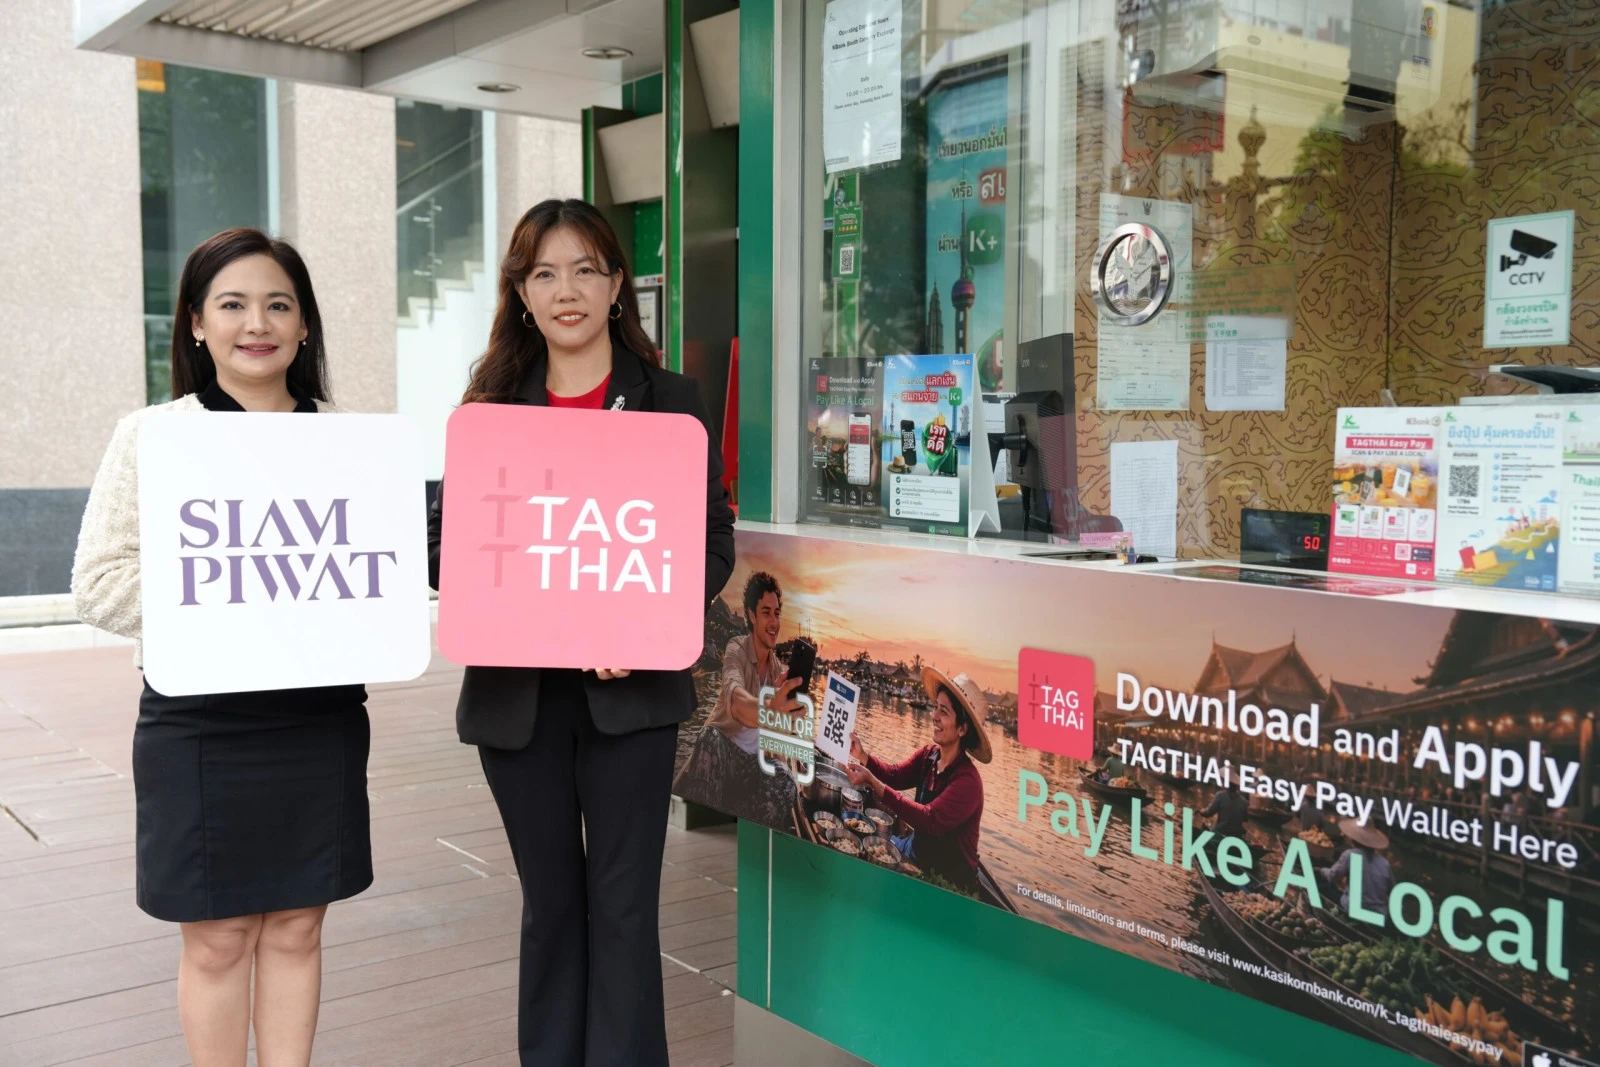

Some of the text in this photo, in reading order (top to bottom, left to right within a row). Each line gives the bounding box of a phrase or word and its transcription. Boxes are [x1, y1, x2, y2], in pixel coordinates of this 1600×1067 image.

[969, 229, 998, 253] K+
[1509, 271, 1545, 286] CCTV
[829, 376, 853, 385] Download
[861, 376, 876, 386] Apply
[926, 372, 956, 387] แลกเงิน
[816, 395, 874, 406] Pay Like A Local
[902, 388, 938, 402] สแกนจ่าย
[950, 392, 961, 401] K+
[1406, 417, 1430, 426] KBank
[1352, 438, 1427, 451] TAGTHAi Easy Pay
[179, 497, 351, 549] SIAM
[526, 495, 657, 544] TAG
[1304, 535, 1321, 550] 50
[178, 551, 398, 606] PIWAT
[525, 545, 672, 593] THAi
[1040, 685, 1079, 709] TAG
[760, 708, 813, 738] SCAN QR
[1040, 704, 1084, 731] THAi
[760, 738, 814, 761] EVERYWHERE
[1116, 672, 1580, 808] Download and Apply
[1116, 738, 1579, 869] TAGTHAi Easy Pay Wallet Here
[1018, 769, 1570, 981] Pay Like A Local
[1017, 883, 1503, 1061] For details, limitations and terms, please visit www.kasikornbank.com/k_tagthaieasypay
